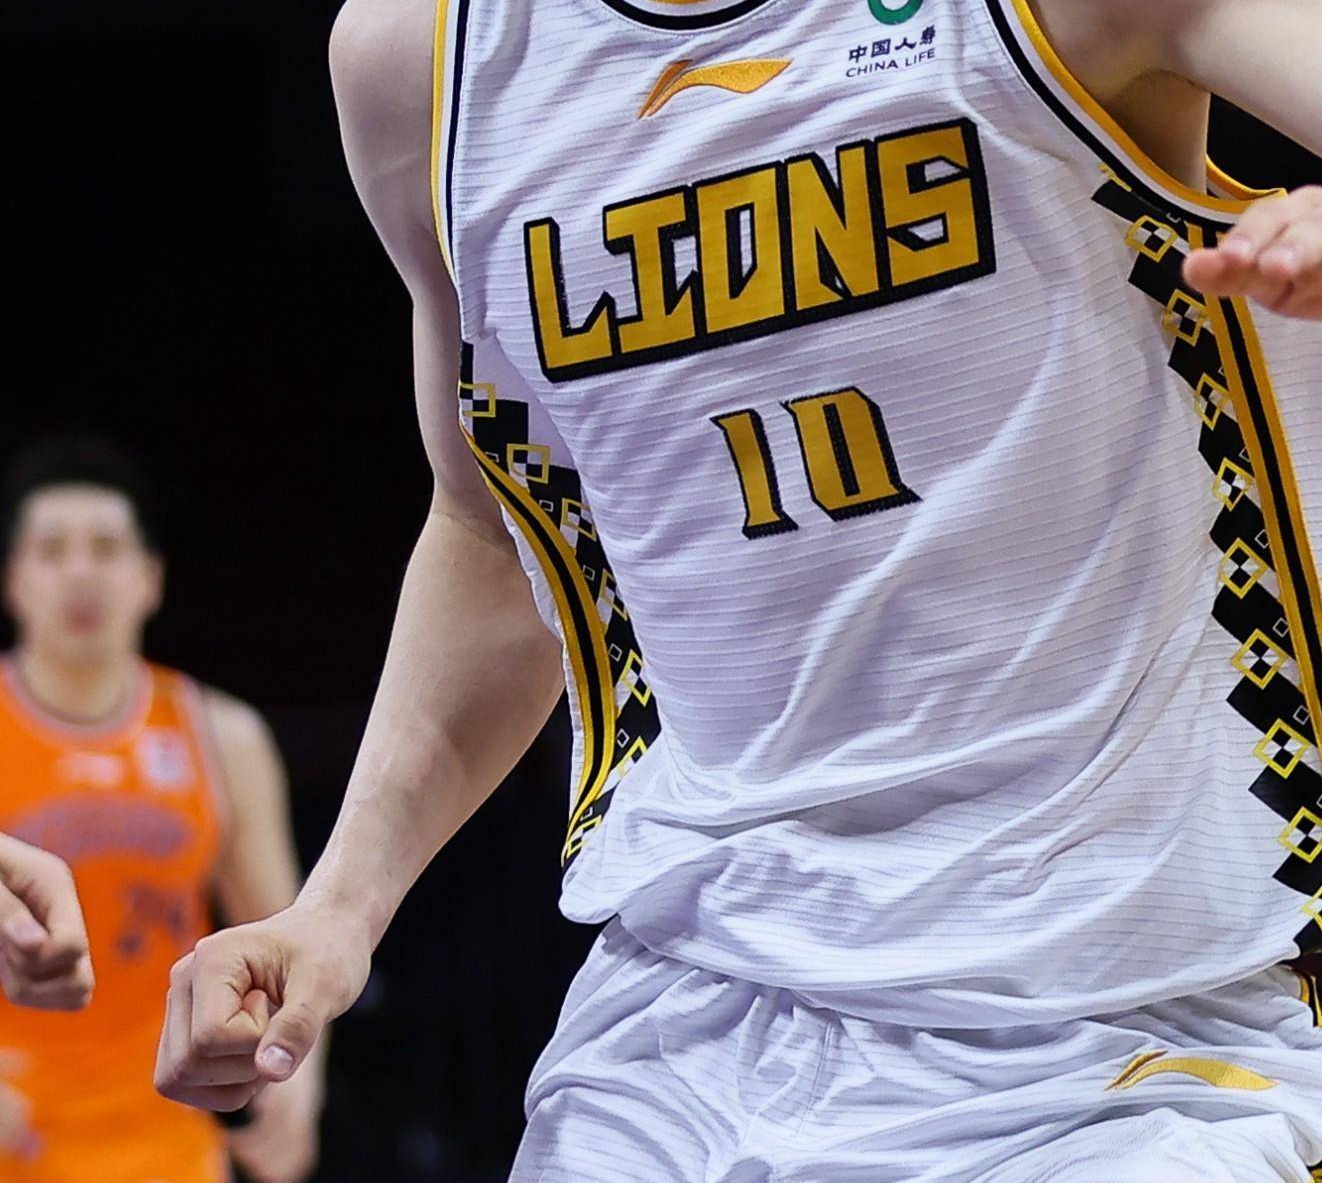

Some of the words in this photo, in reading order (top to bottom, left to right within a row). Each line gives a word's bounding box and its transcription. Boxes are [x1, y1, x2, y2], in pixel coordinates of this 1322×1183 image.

[845, 60, 899, 77] CHINA
[905, 48, 936, 67] LIFE
[523, 118, 997, 383] LIONS
[709, 385, 923, 540] 10
